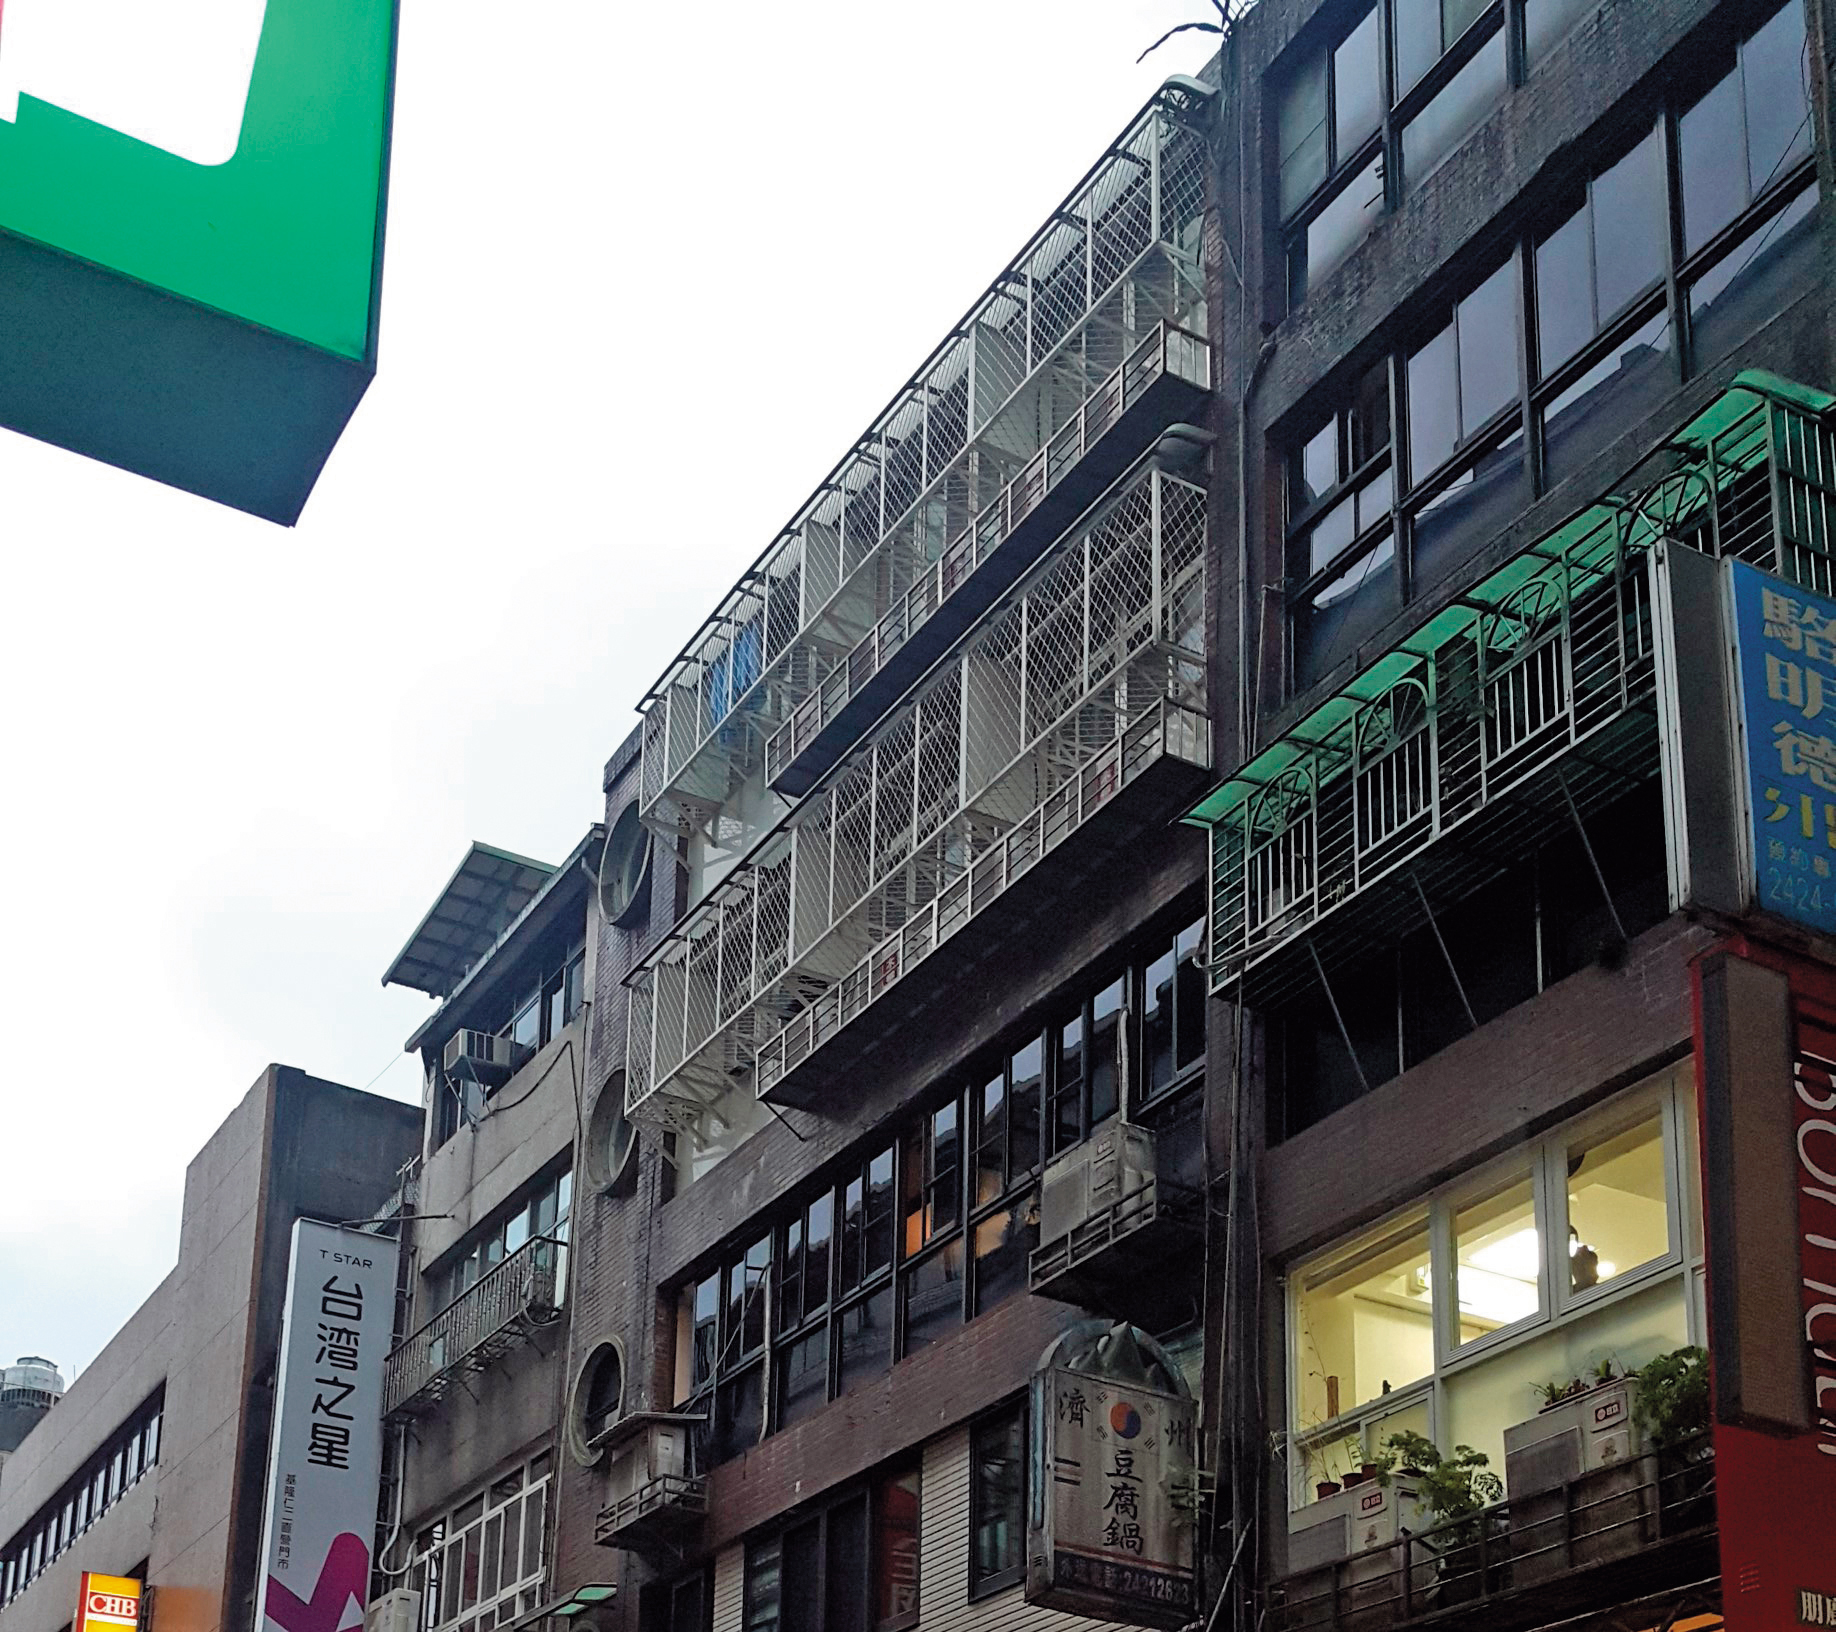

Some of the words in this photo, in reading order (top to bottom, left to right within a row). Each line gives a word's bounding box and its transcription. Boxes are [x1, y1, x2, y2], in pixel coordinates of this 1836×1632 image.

[320, 1249, 328, 1259] T
[333, 1252, 373, 1268] STAR
[1102, 1450, 1144, 1556] 豆腐鍋
[89, 1594, 137, 1618] CHB
